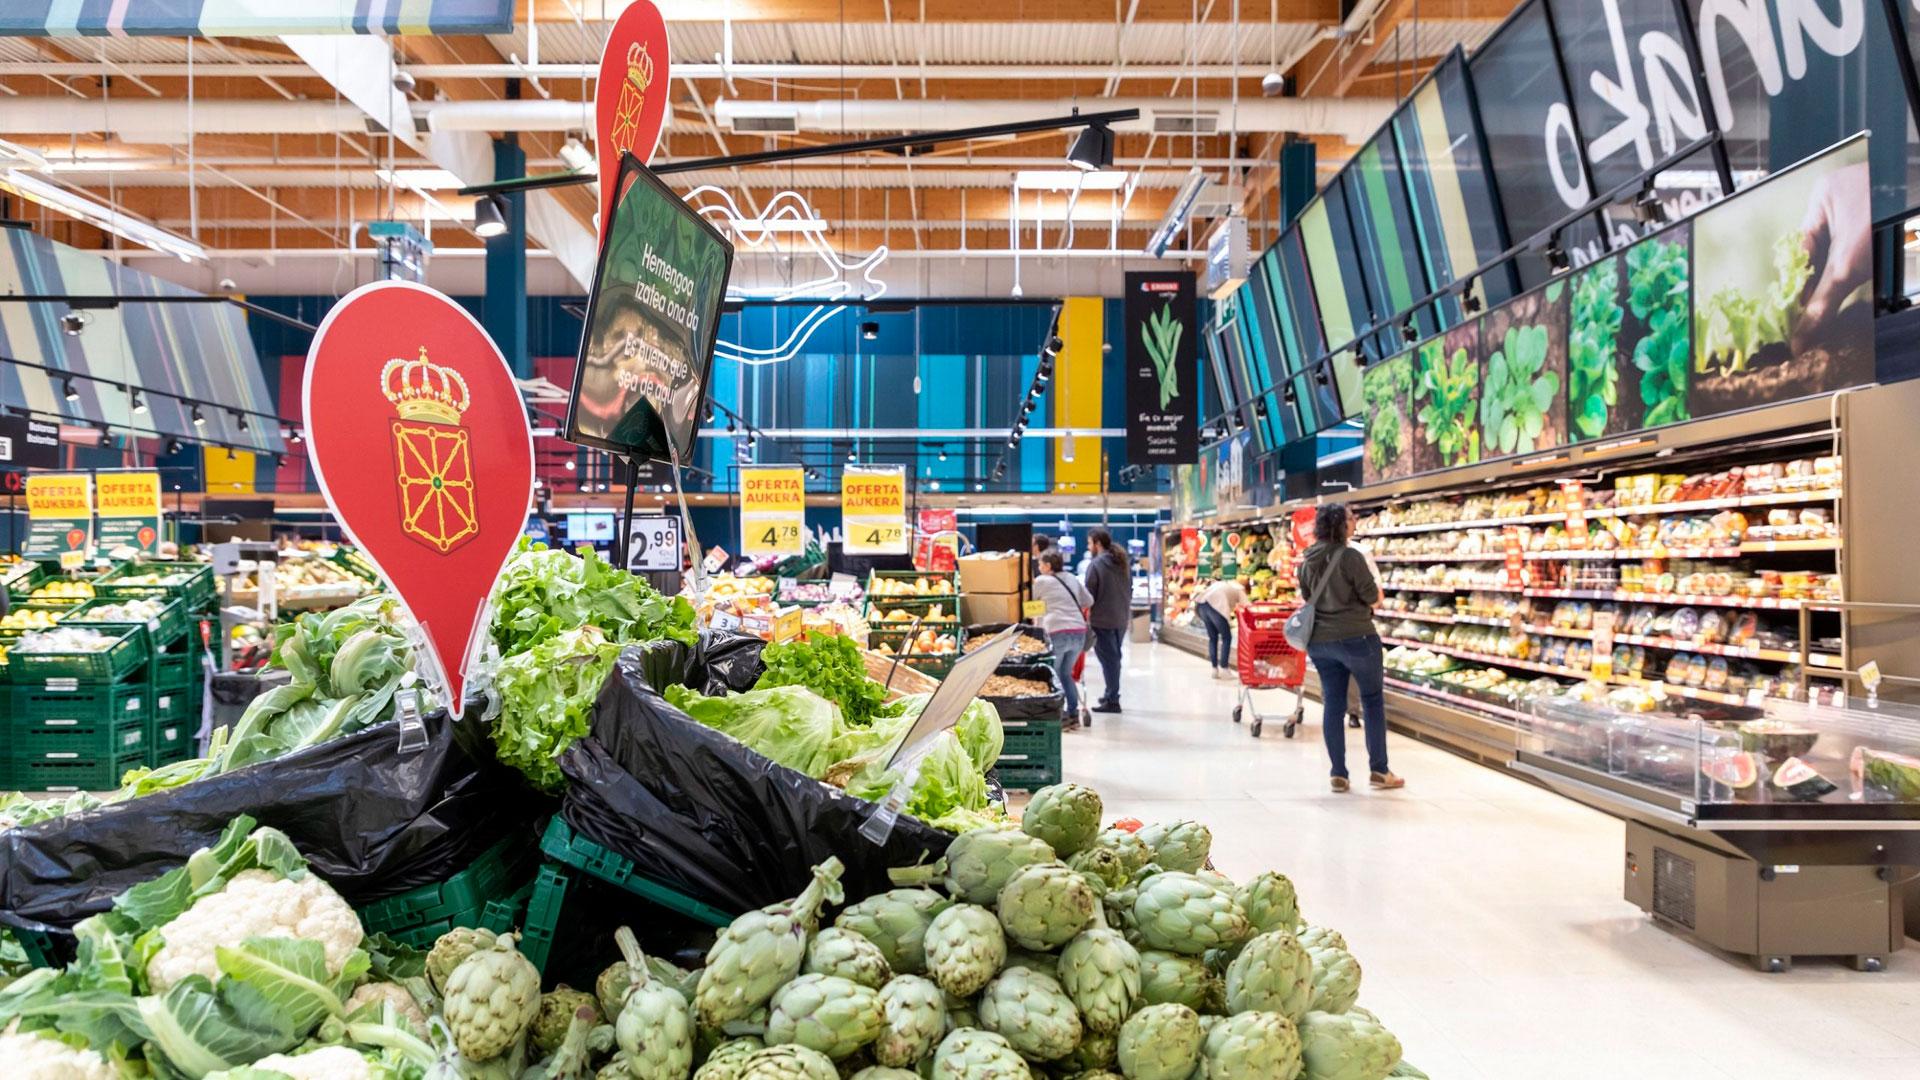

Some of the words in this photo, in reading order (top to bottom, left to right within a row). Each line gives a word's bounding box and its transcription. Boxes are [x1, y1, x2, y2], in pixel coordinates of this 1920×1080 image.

[641, 243, 694, 296] Hemengoa
[634, 275, 667, 313] izatea
[667, 300, 686, 326] ona
[686, 304, 699, 332] da
[624, 332, 637, 358] Es
[638, 338, 670, 372] bueno
[670, 358, 688, 380] que
[618, 368, 638, 393] sea
[640, 373, 654, 396] de
[654, 383, 679, 408] aquí
[102, 483, 153, 494] OFERTA
[745, 479, 800, 490] OFERTA
[845, 484, 900, 495] OFERTA
[30, 486, 83, 497] OFERTA
[103, 496, 154, 507] AUKERA
[745, 492, 801, 504] AUKERA
[845, 496, 900, 508] AUKERA
[33, 499, 86, 510] AUKERA
[630, 530, 675, 567] 2,99
